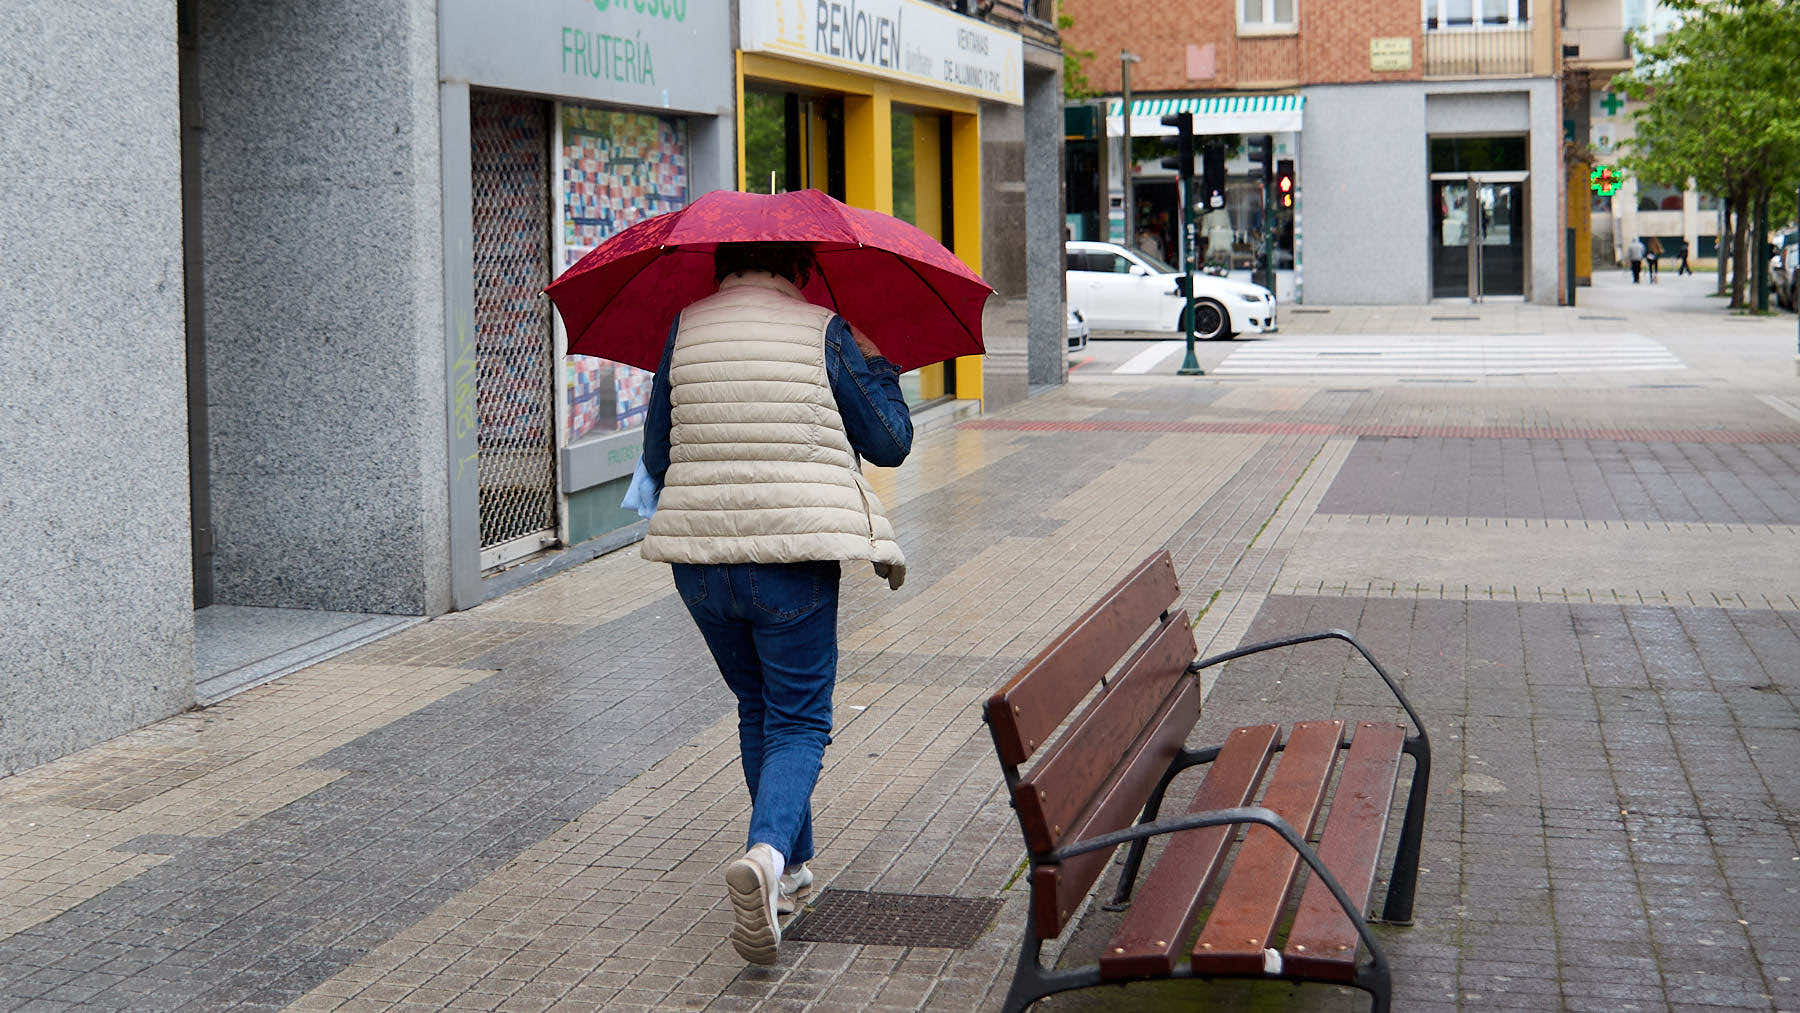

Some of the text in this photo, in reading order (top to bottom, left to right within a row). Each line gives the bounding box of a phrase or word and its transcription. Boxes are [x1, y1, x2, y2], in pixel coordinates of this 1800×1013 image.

[562, 26, 655, 86] FRUTERÍA
[816, 0, 902, 70] RENOVEN
[943, 58, 953, 82] DE
